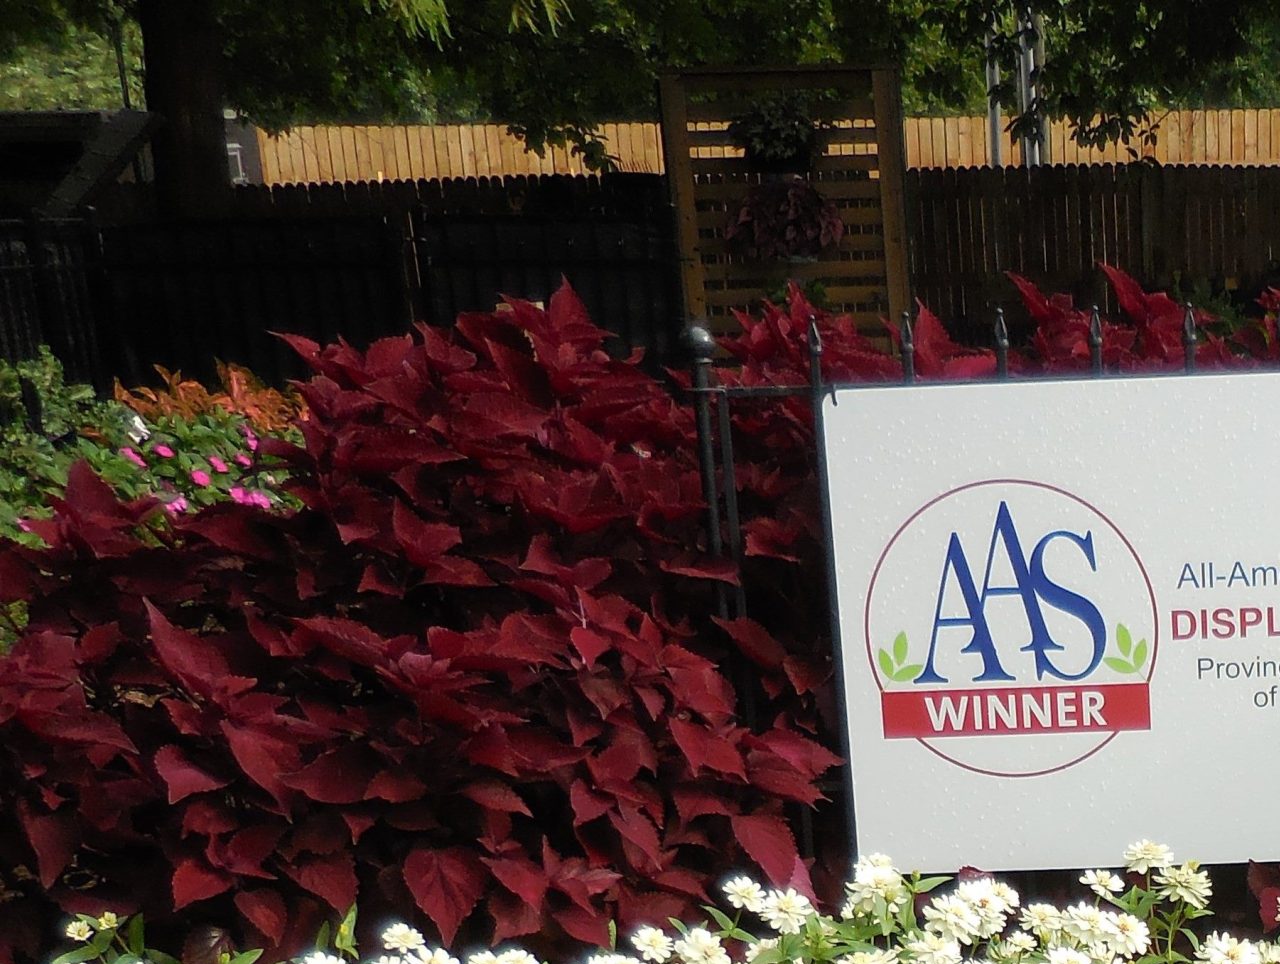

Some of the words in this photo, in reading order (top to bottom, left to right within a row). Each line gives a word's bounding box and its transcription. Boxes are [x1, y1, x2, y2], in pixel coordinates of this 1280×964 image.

[913, 500, 1108, 685] AAS
[924, 691, 1107, 732] WINNER
[1253, 683, 1277, 708] of
